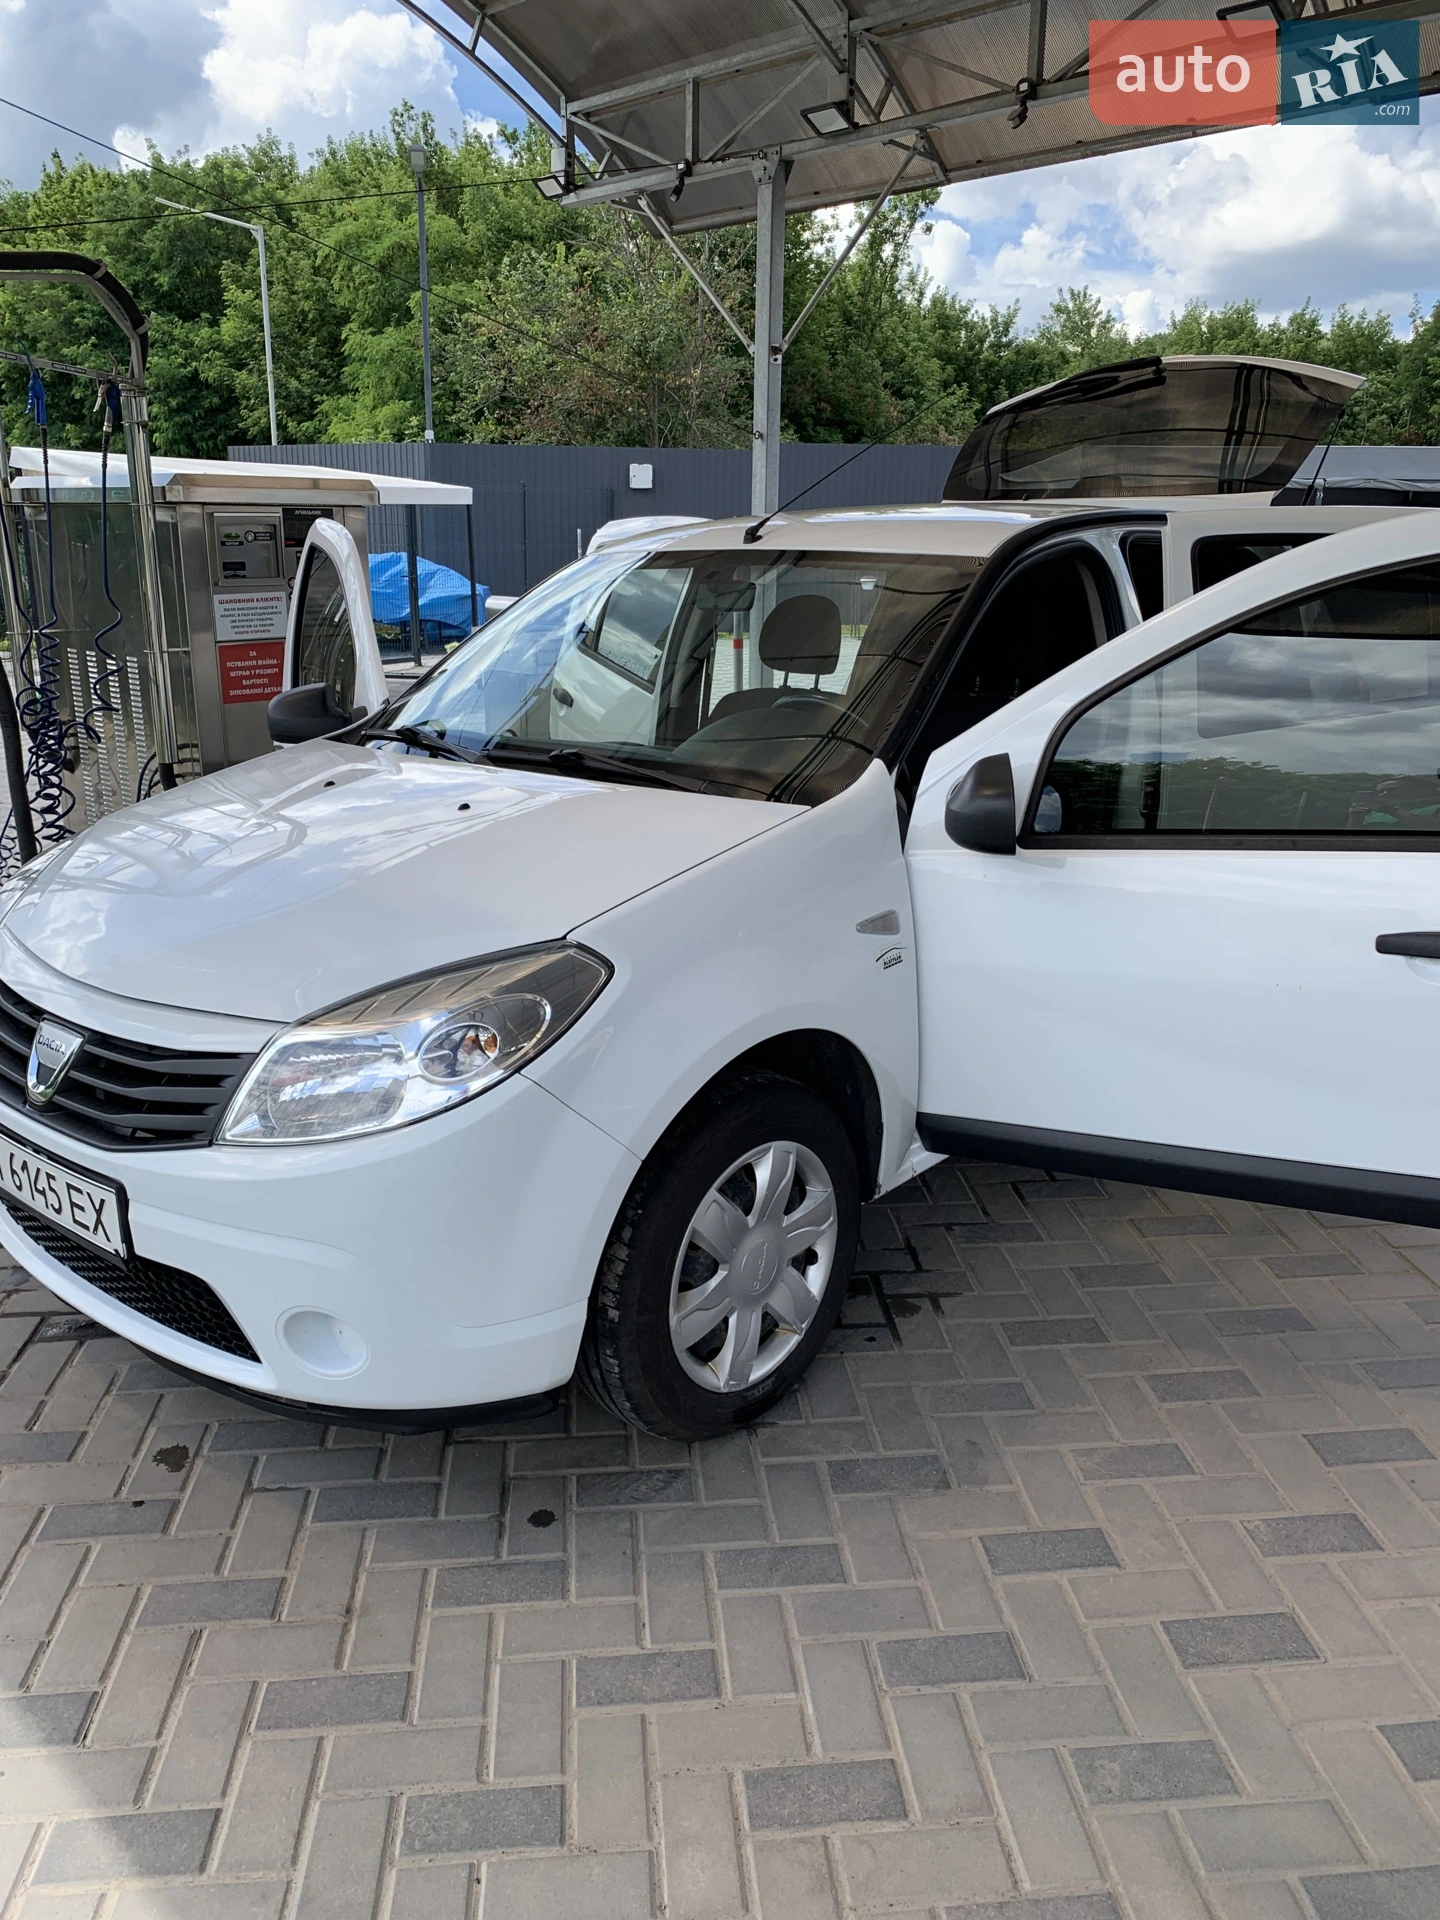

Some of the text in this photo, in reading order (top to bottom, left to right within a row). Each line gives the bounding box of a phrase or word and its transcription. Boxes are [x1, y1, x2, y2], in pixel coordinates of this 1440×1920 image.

[218, 597, 255, 605] ШАНОВНИЙ
[257, 658, 277, 666] МАЙНА
[229, 687, 264, 696] ЗІПСОВАНОЇ
[37, 1032, 66, 1056] DACIA
[9, 1152, 111, 1243] 6145 EX
